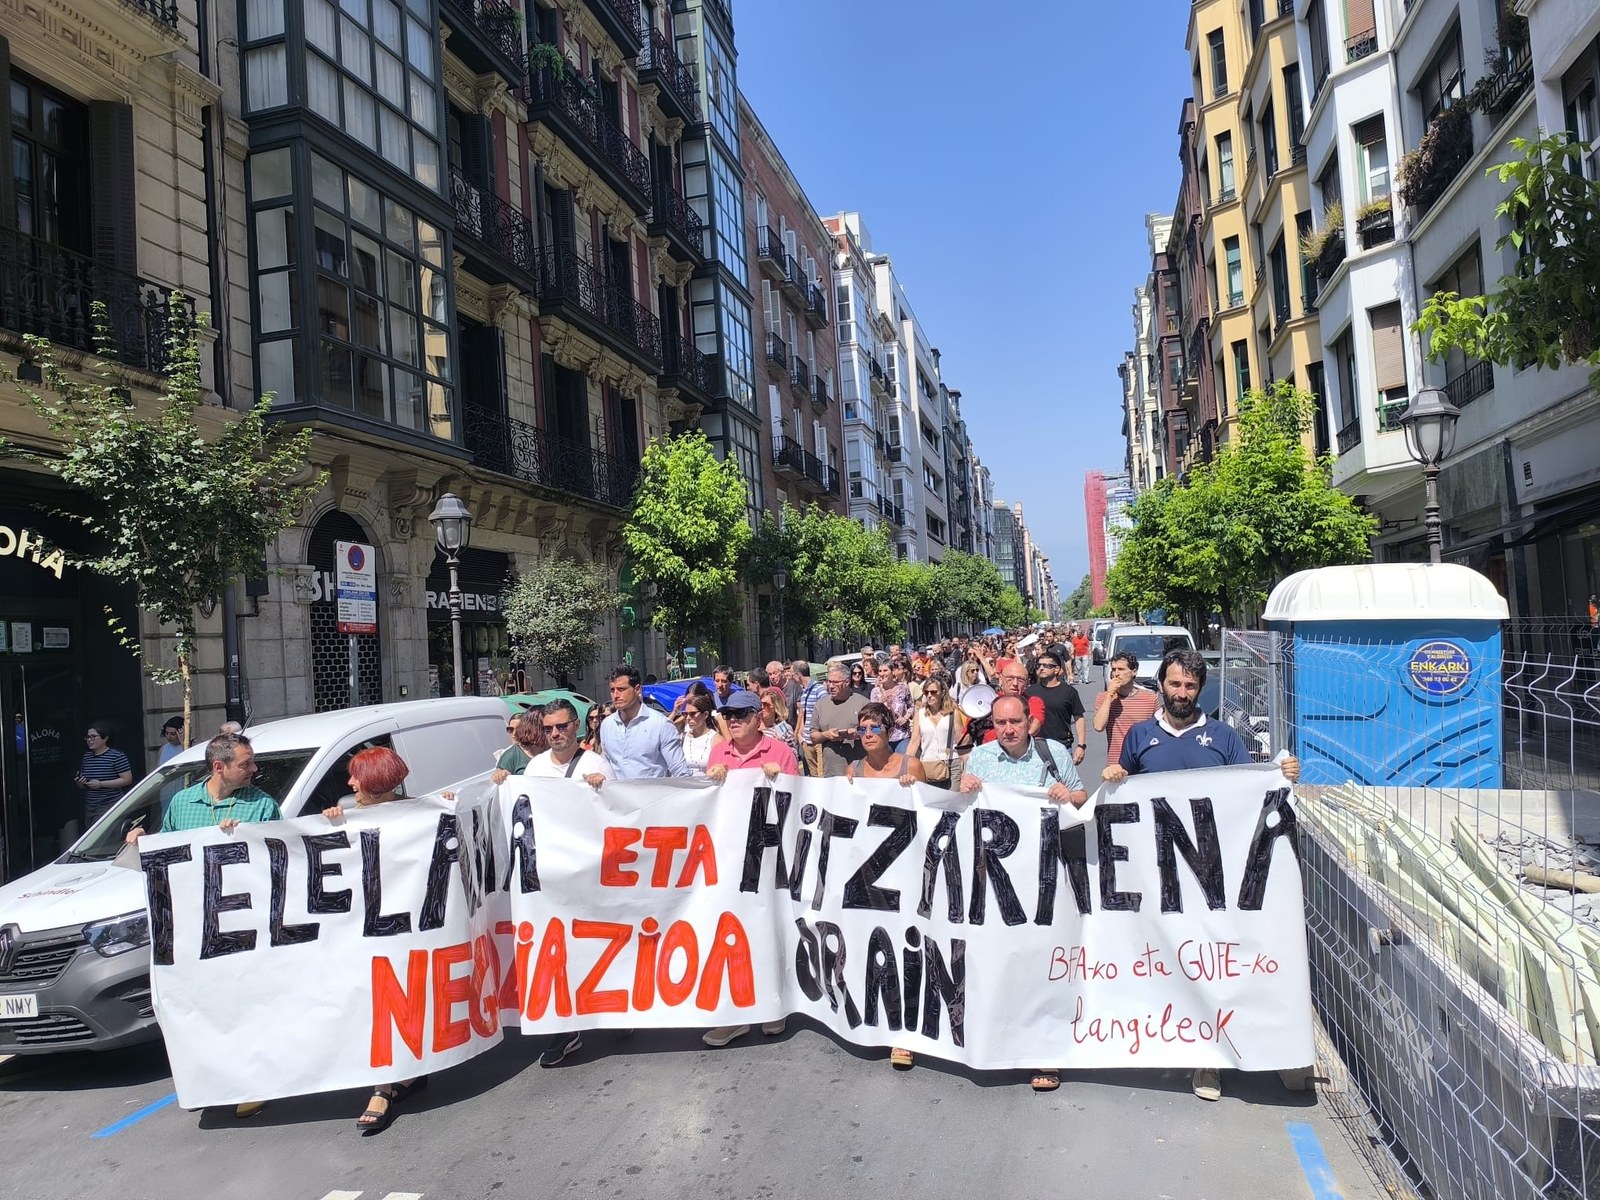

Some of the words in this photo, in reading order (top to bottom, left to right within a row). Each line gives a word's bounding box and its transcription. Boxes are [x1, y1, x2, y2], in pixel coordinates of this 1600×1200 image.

[1411, 661, 1469, 672] ENKARKI
[31, 729, 60, 742] ALOHA
[600, 824, 717, 887] ETA
[1132, 942, 1172, 977] eta
[6, 998, 31, 1015] NMY
